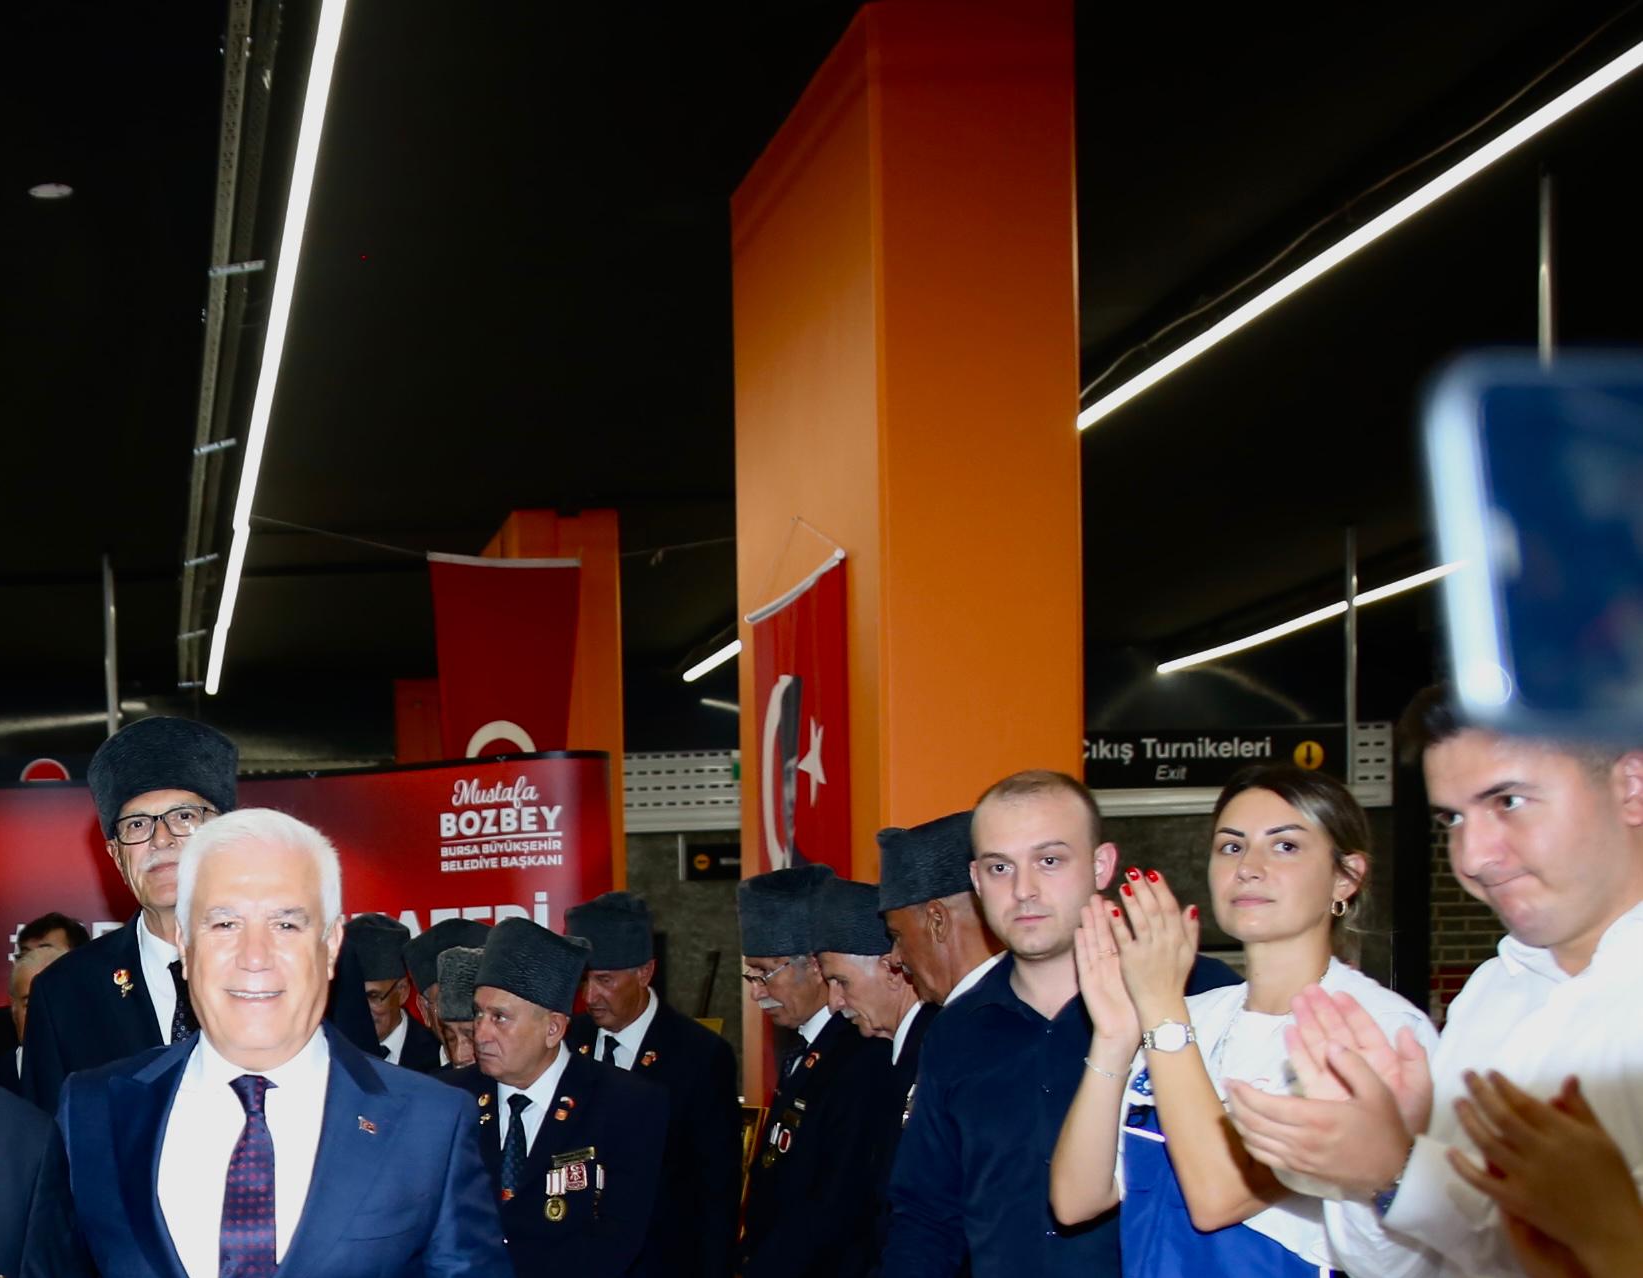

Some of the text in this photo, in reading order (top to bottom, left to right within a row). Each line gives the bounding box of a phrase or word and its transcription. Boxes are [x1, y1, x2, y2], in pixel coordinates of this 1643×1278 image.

[1141, 736, 1272, 758] Turnikeleri
[1155, 765, 1187, 780] Exit
[451, 776, 539, 809] Mustafa
[439, 805, 563, 838] BOZBEY
[441, 838, 562, 857] BURSA BÜYÜKŞEHİR
[441, 855, 562, 871] BELEDİYE BAŞKANI
